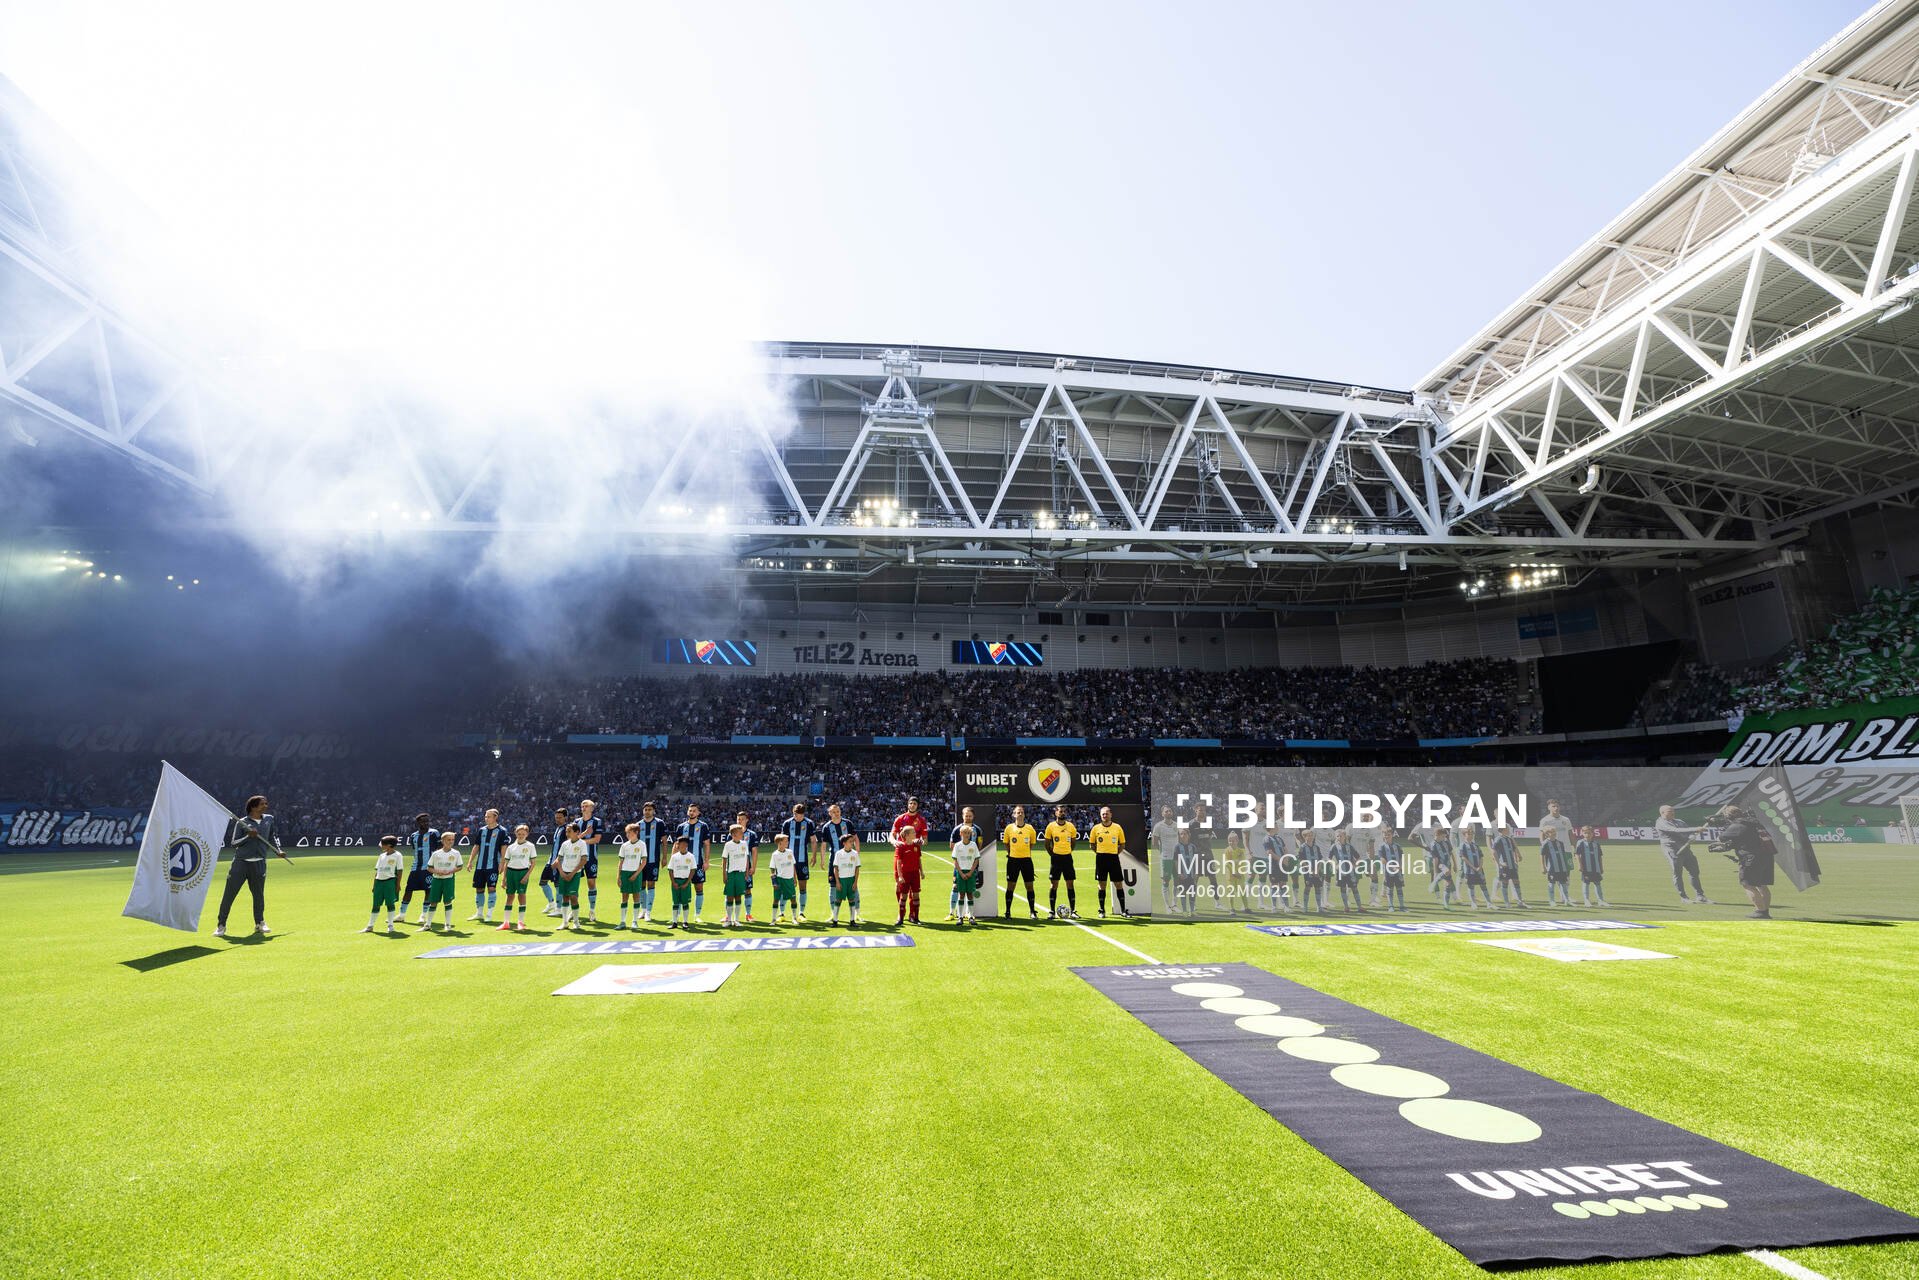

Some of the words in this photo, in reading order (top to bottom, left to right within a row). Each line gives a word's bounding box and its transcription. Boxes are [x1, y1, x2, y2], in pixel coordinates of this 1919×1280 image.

[793, 642, 855, 665] TELE2
[859, 648, 920, 667] Arena
[966, 774, 1018, 786] UNIBET
[1081, 774, 1131, 786] UNIBET
[8, 810, 61, 845] till
[62, 811, 142, 845] dans!
[314, 836, 364, 846] ELEDA
[518, 935, 900, 956] ALLSVENSKAN
[1110, 967, 1225, 977] UNIBET
[1445, 1160, 1723, 1200] UNIBET
